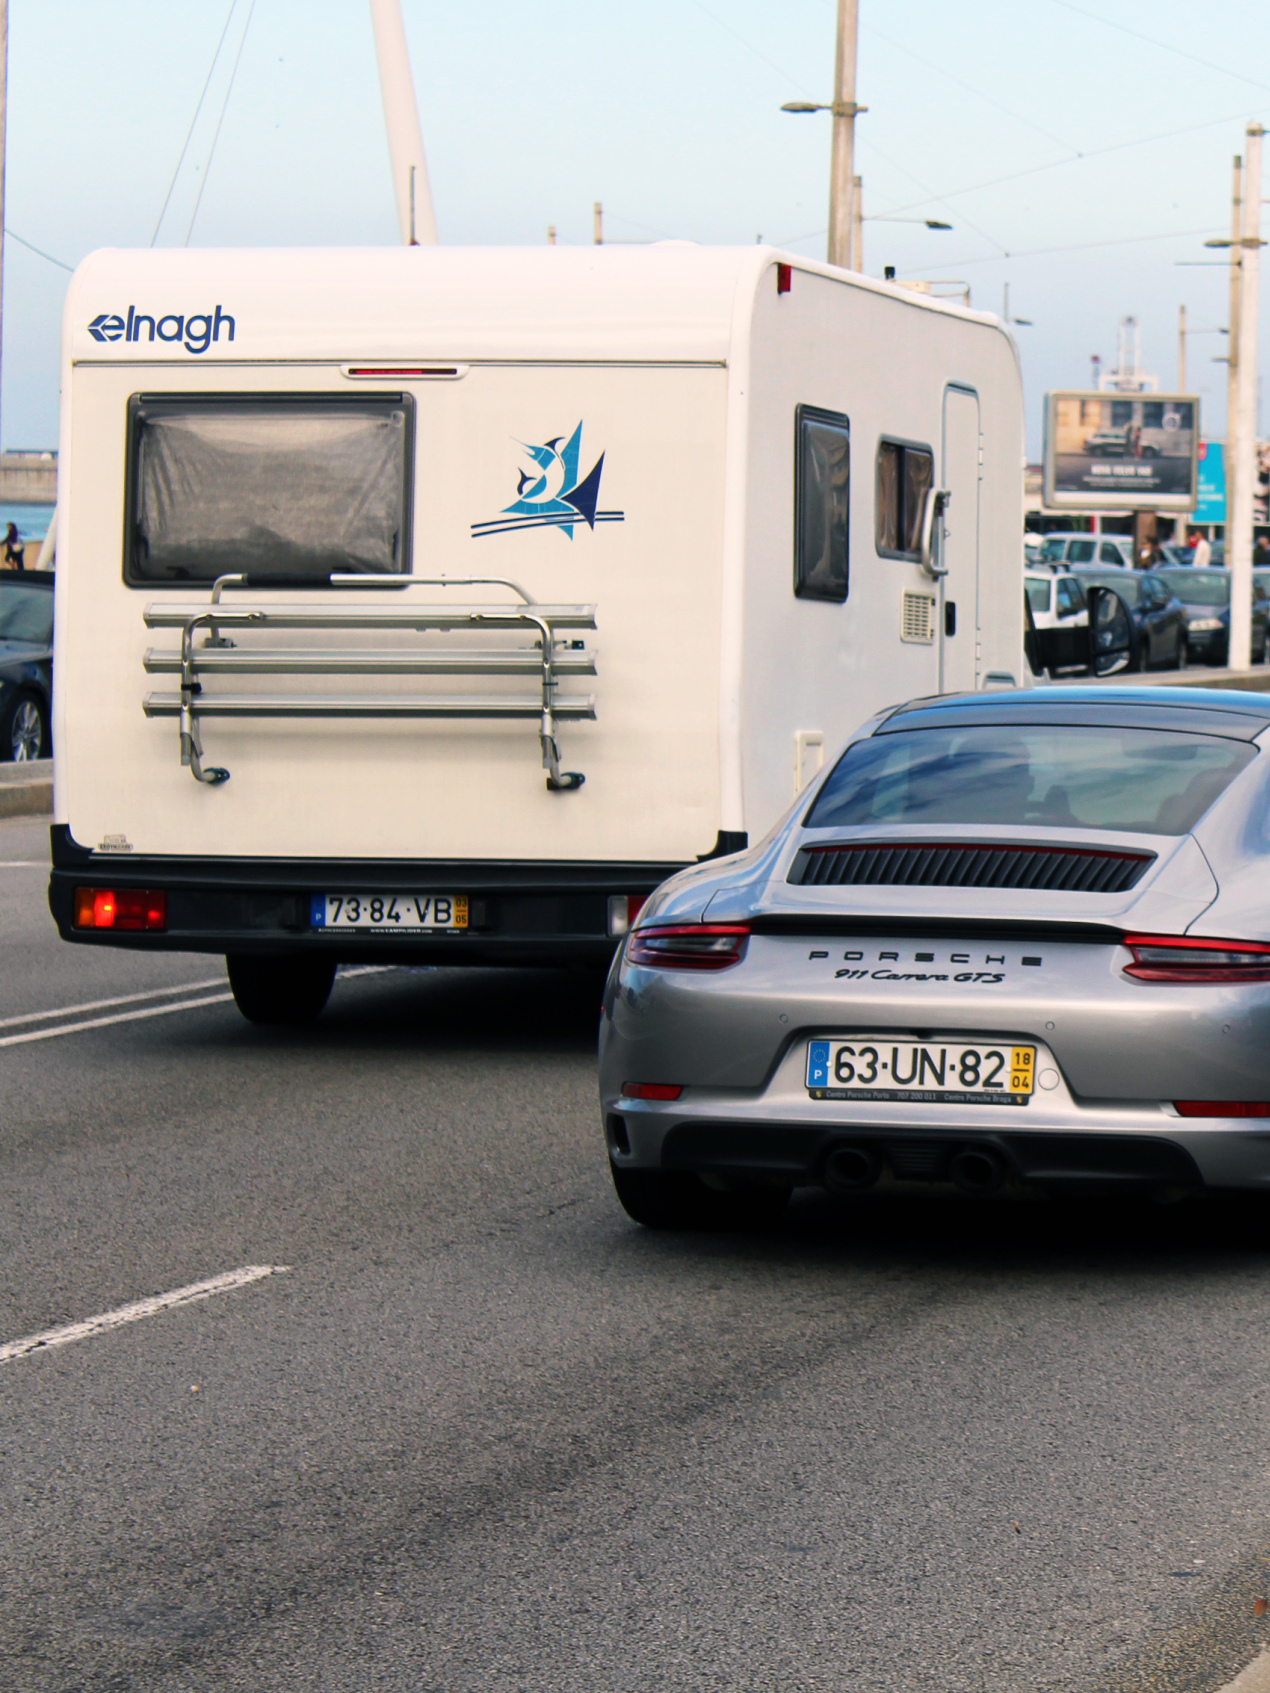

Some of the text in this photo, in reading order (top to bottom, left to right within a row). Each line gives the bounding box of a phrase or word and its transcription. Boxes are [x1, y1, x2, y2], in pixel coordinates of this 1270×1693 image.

[88, 305, 236, 354] elnagh
[456, 914, 467, 924] 05
[808, 950, 1043, 967] PORSCHE
[834, 968, 1006, 983] 911 Carrera GTS
[1015, 1052, 1031, 1065] 18
[814, 1070, 822, 1079] P
[1012, 1076, 1030, 1088] 04
[847, 1091, 871, 1099] Porsche
[966, 1094, 990, 1102] Porsche
